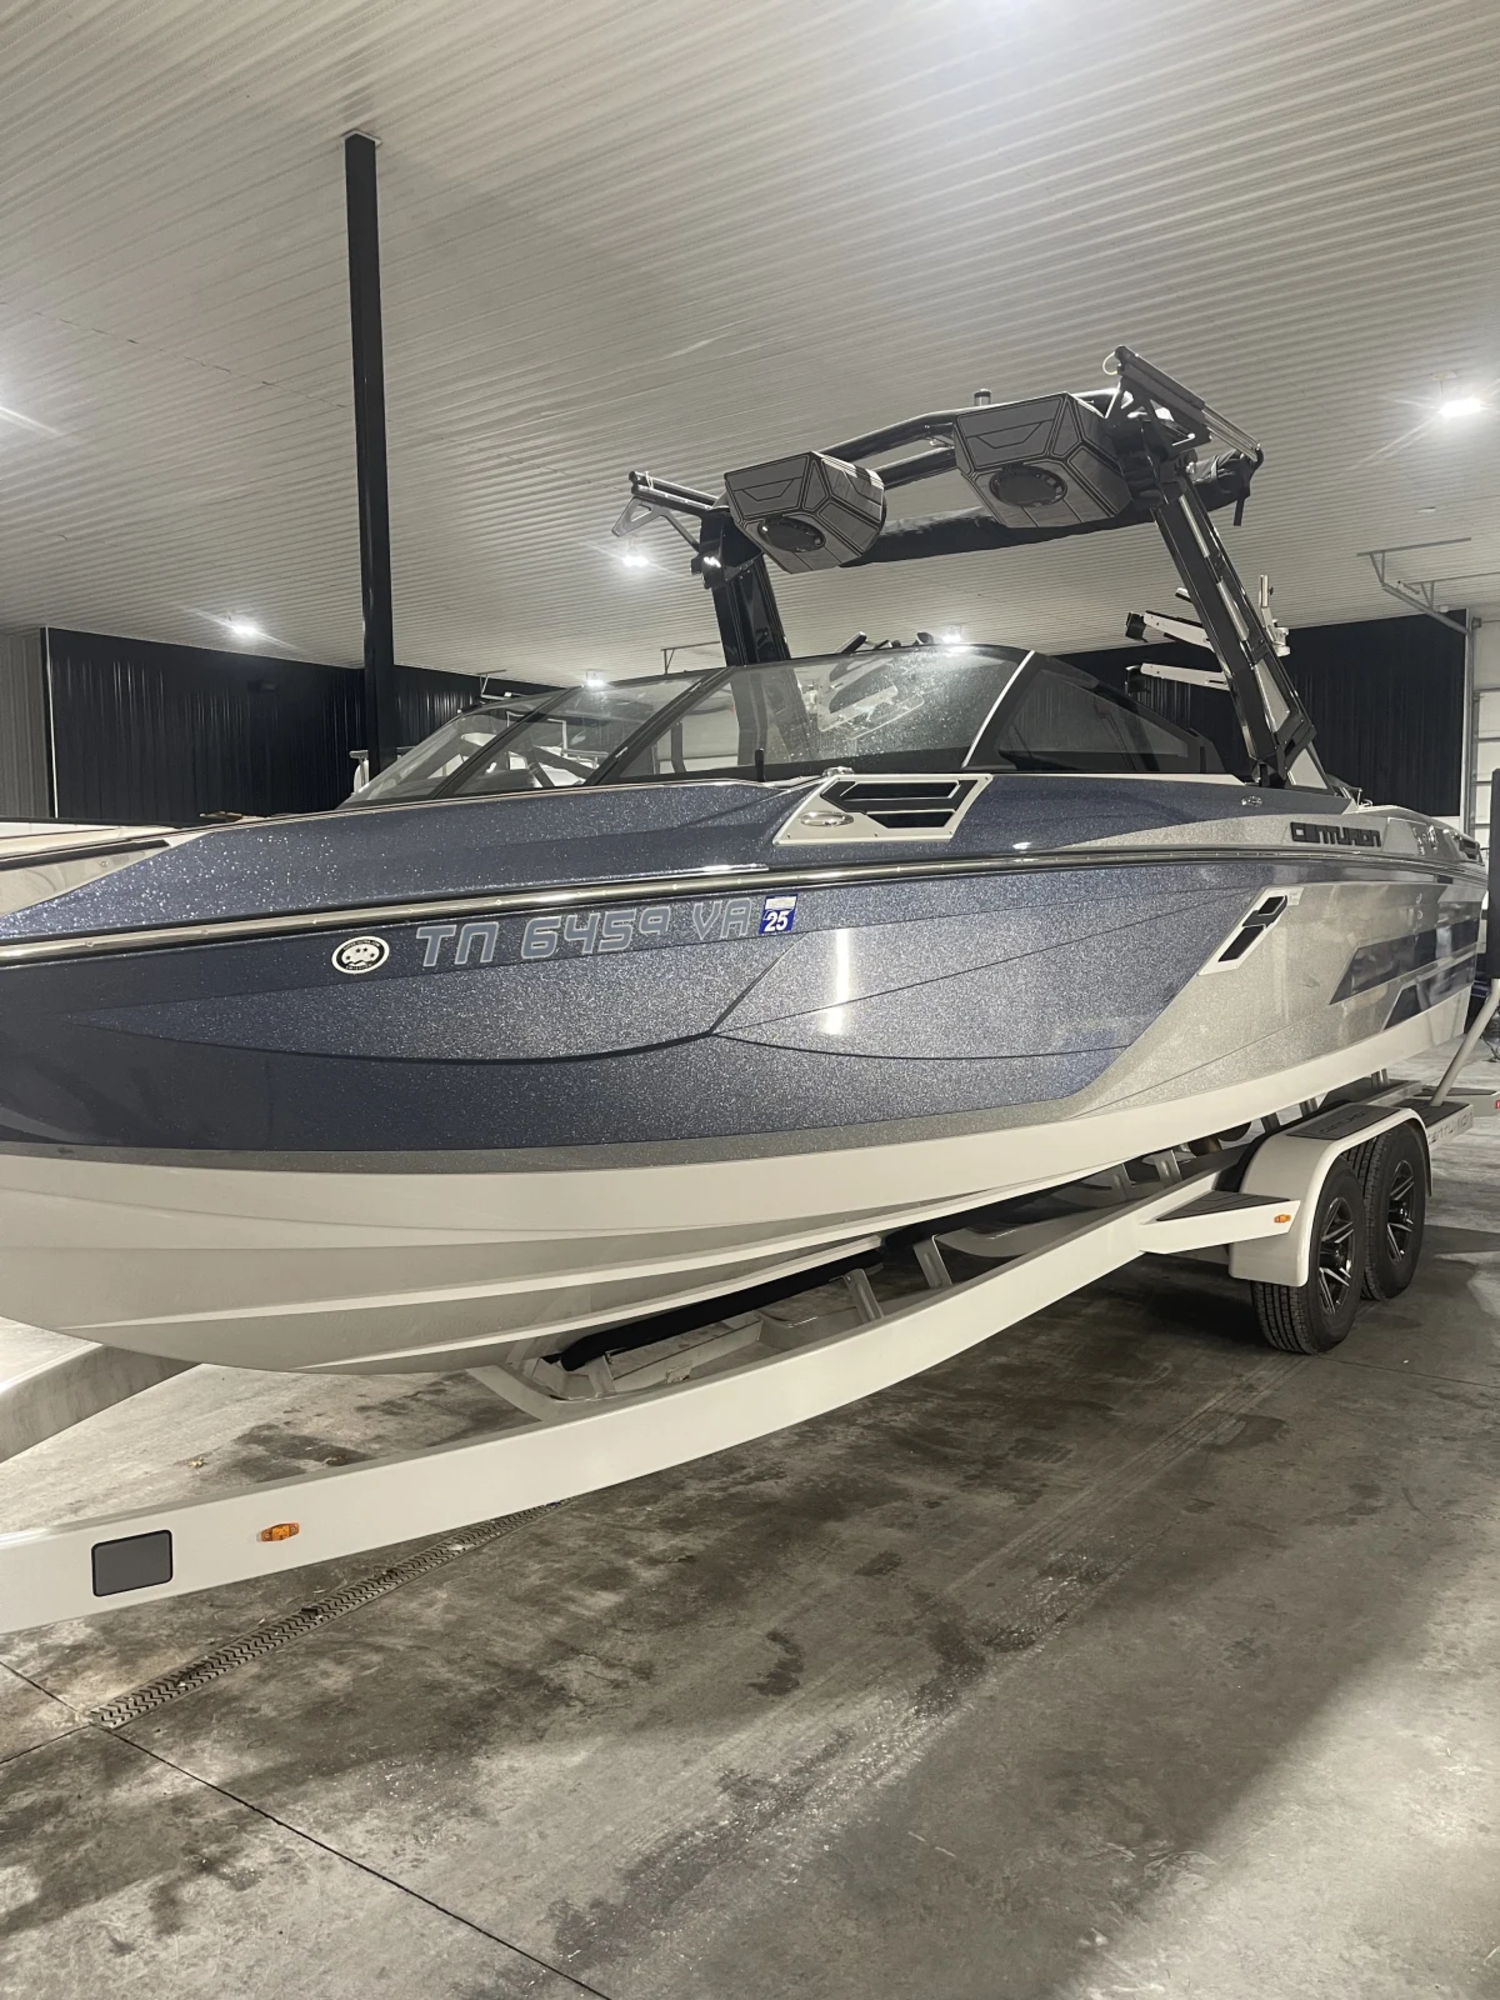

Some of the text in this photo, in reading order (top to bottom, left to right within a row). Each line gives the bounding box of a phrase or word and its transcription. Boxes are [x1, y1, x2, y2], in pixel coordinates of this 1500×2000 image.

[416, 897, 752, 967] TN 6459 VA
[763, 910, 789, 932] 25
